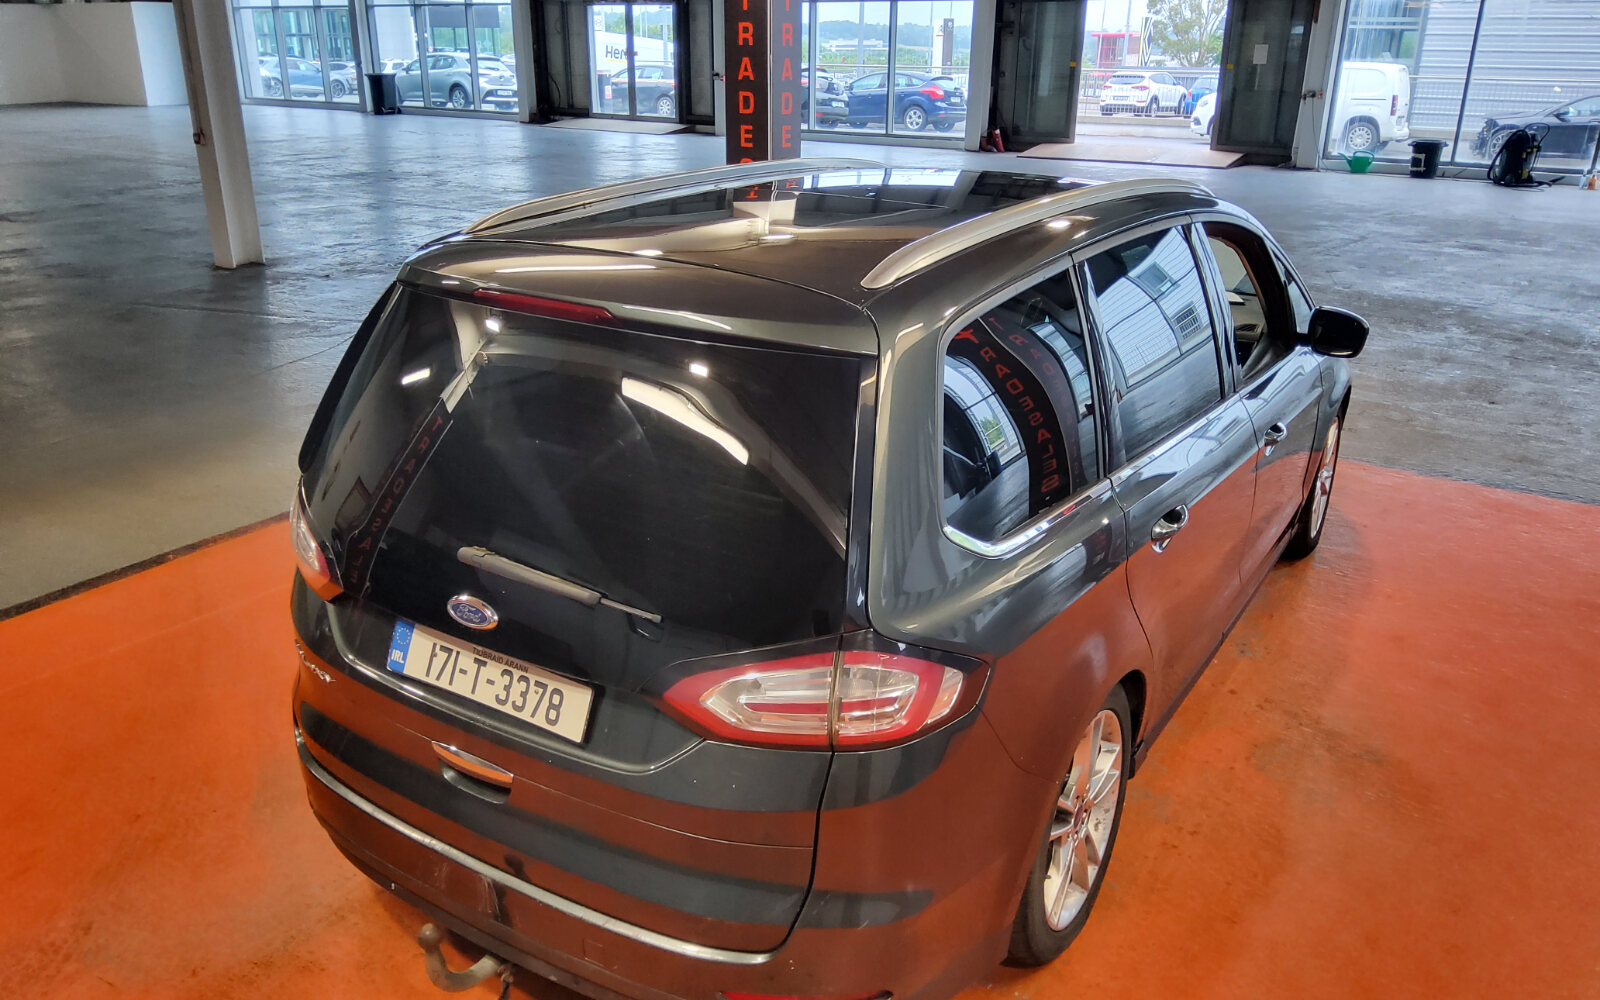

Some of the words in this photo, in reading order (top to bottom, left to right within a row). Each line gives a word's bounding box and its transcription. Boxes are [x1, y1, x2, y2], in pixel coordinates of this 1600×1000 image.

[738, 0, 755, 164] RADE
[391, 648, 405, 664] IRL
[425, 642, 565, 727] 171-T-3378
